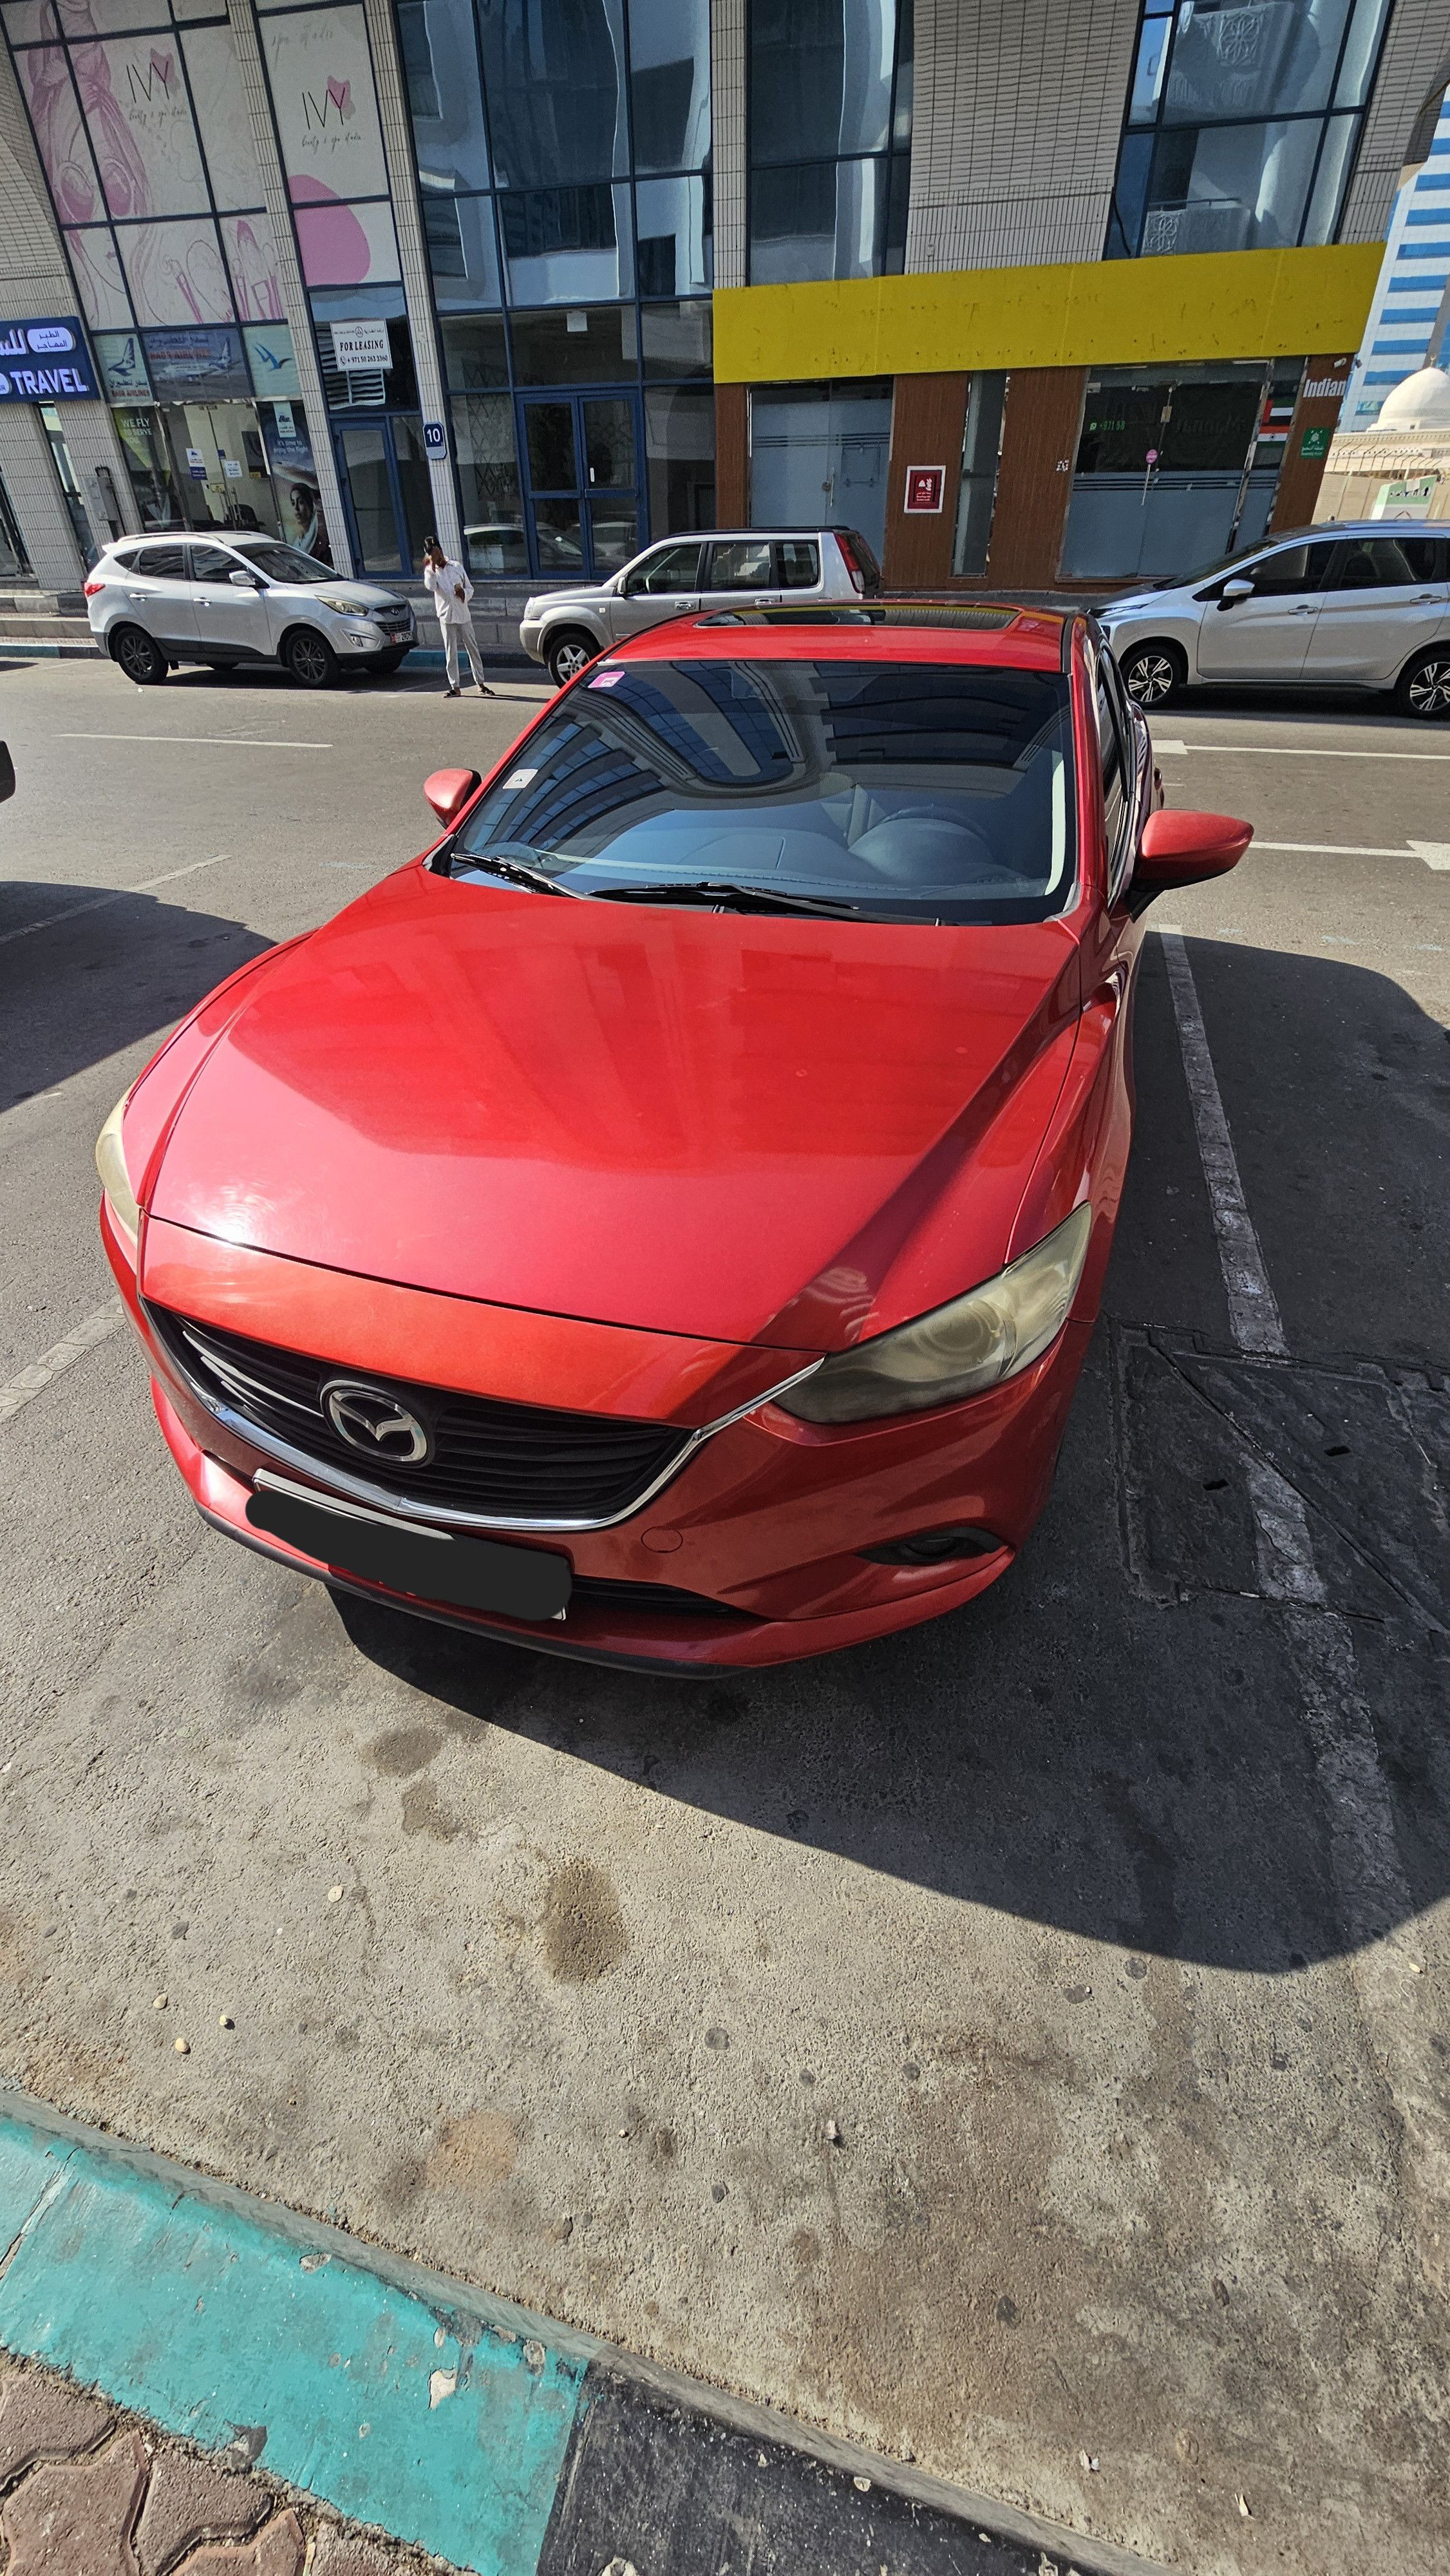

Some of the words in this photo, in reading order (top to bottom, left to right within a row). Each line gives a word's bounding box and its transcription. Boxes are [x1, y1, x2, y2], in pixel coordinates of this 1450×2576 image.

[126, 61, 169, 103] IVY
[302, 87, 345, 130] IVY
[39, 330, 61, 340] الطير
[37, 340, 68, 350] المهاجر
[340, 342, 353, 351] FOR
[355, 339, 383, 350] LEASING
[10, 368, 89, 394] TRAVEL
[1303, 378, 1346, 397] Indian
[135, 417, 149, 427] FLY
[427, 428, 440, 443] 10
